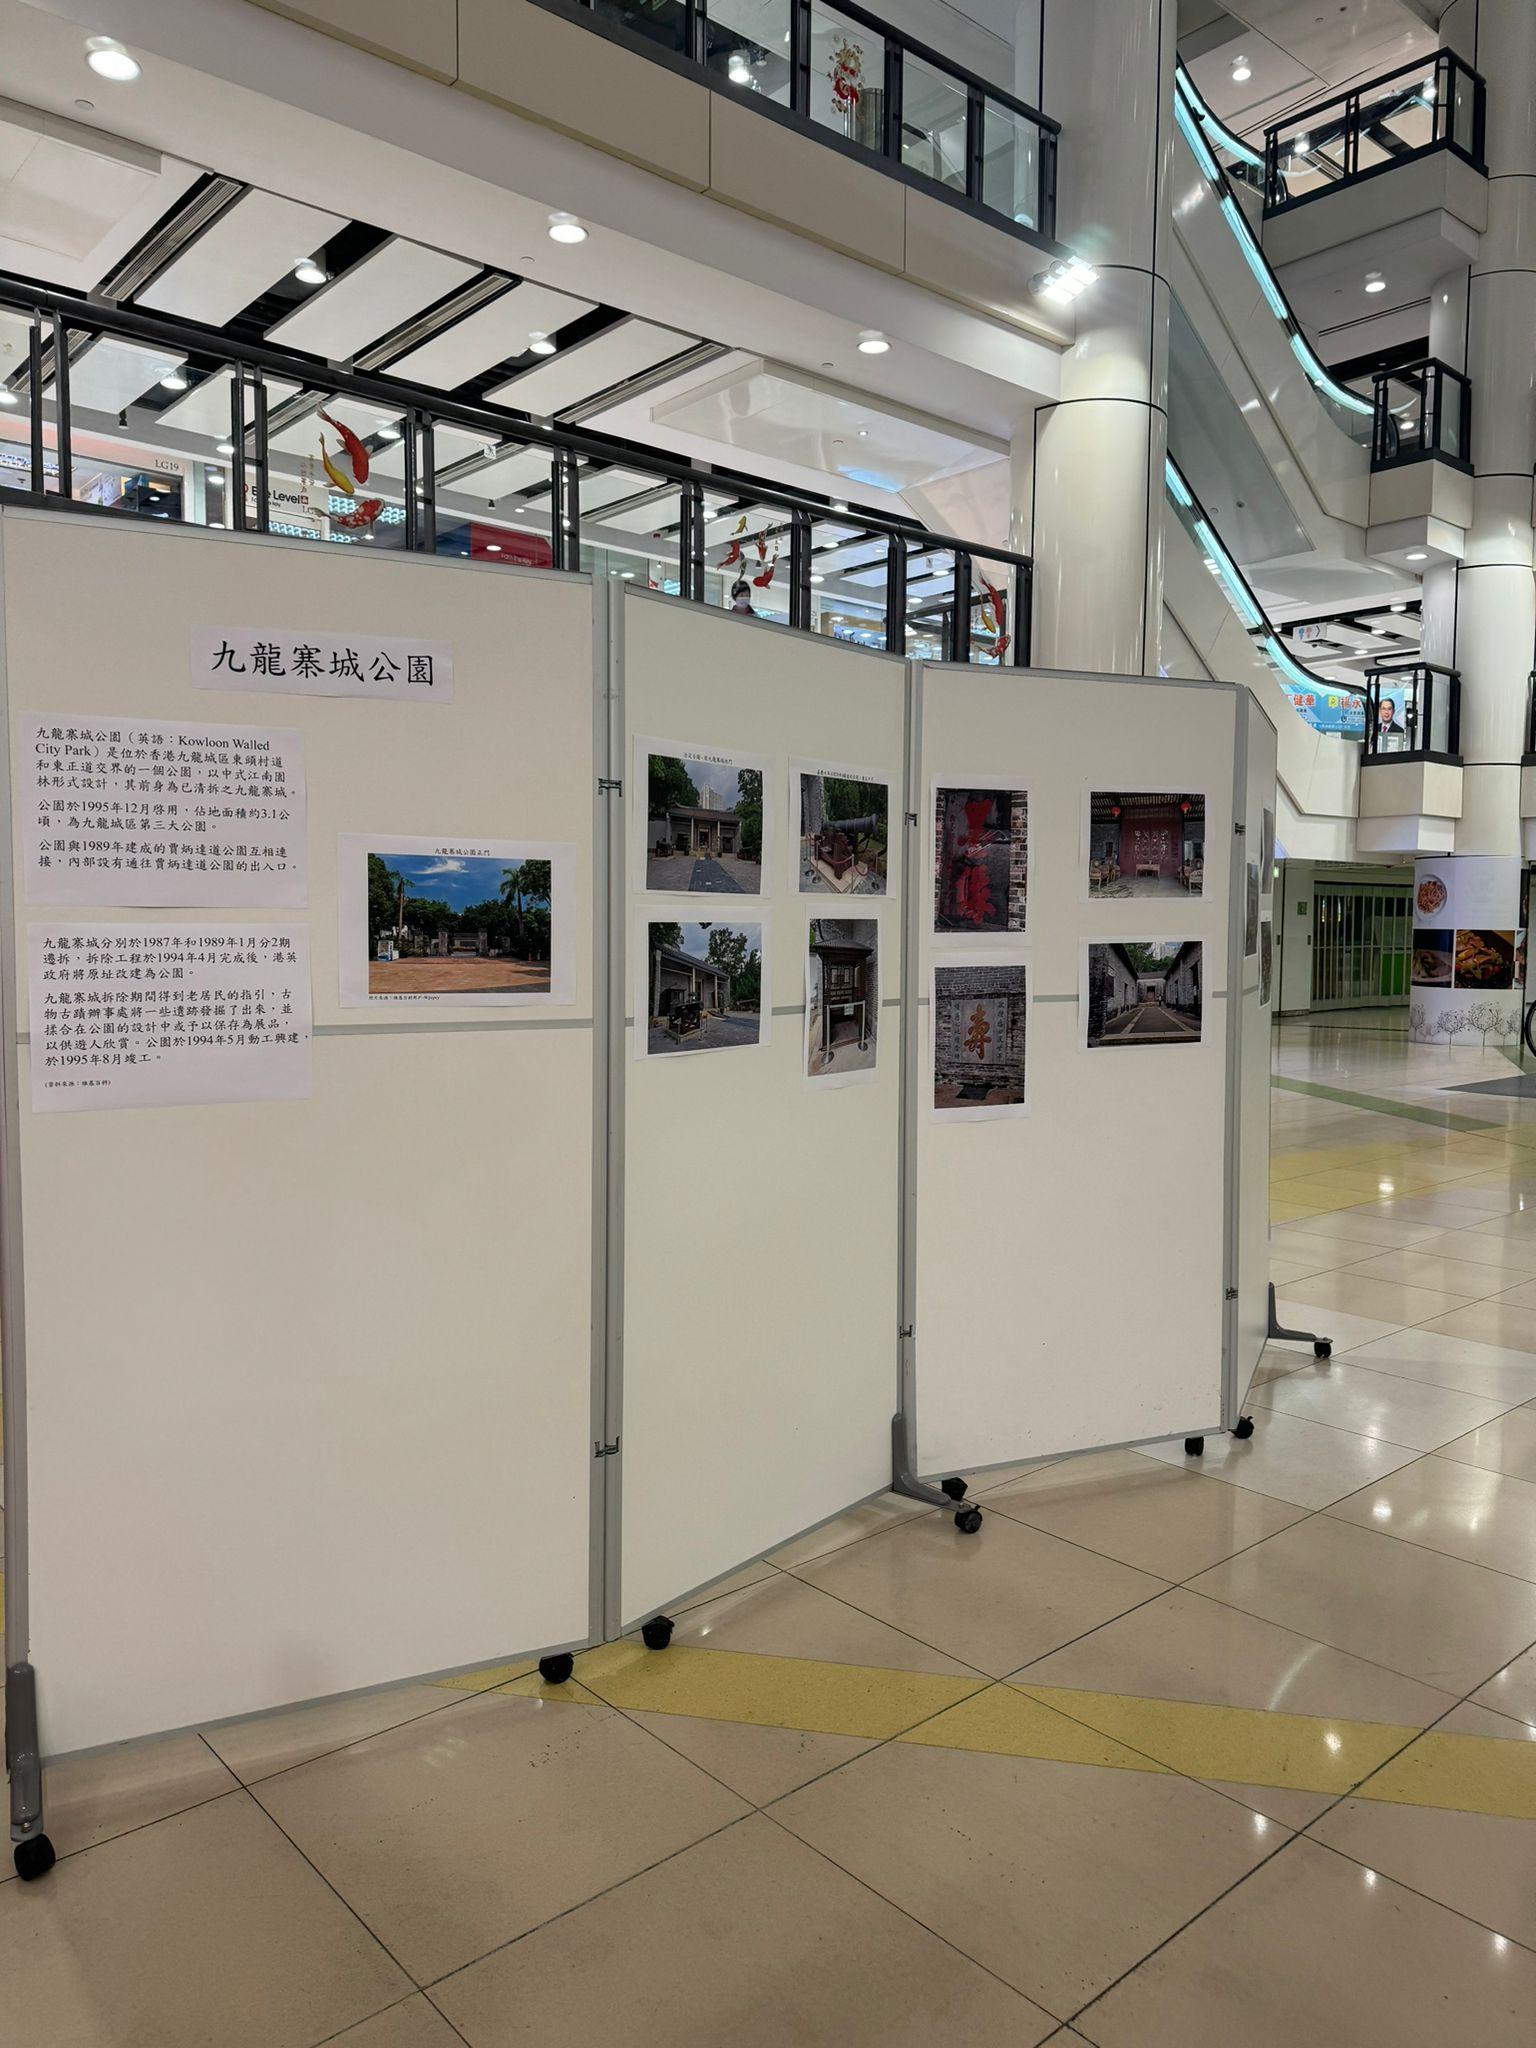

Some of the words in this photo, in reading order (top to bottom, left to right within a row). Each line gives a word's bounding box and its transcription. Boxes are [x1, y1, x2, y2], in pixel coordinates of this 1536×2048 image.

[155, 459, 180, 472] LG19
[273, 490, 300, 505] Level
[210, 640, 434, 686] 九龍寨城公園
[35, 743, 60, 757] City
[232, 738, 270, 751] Walled
